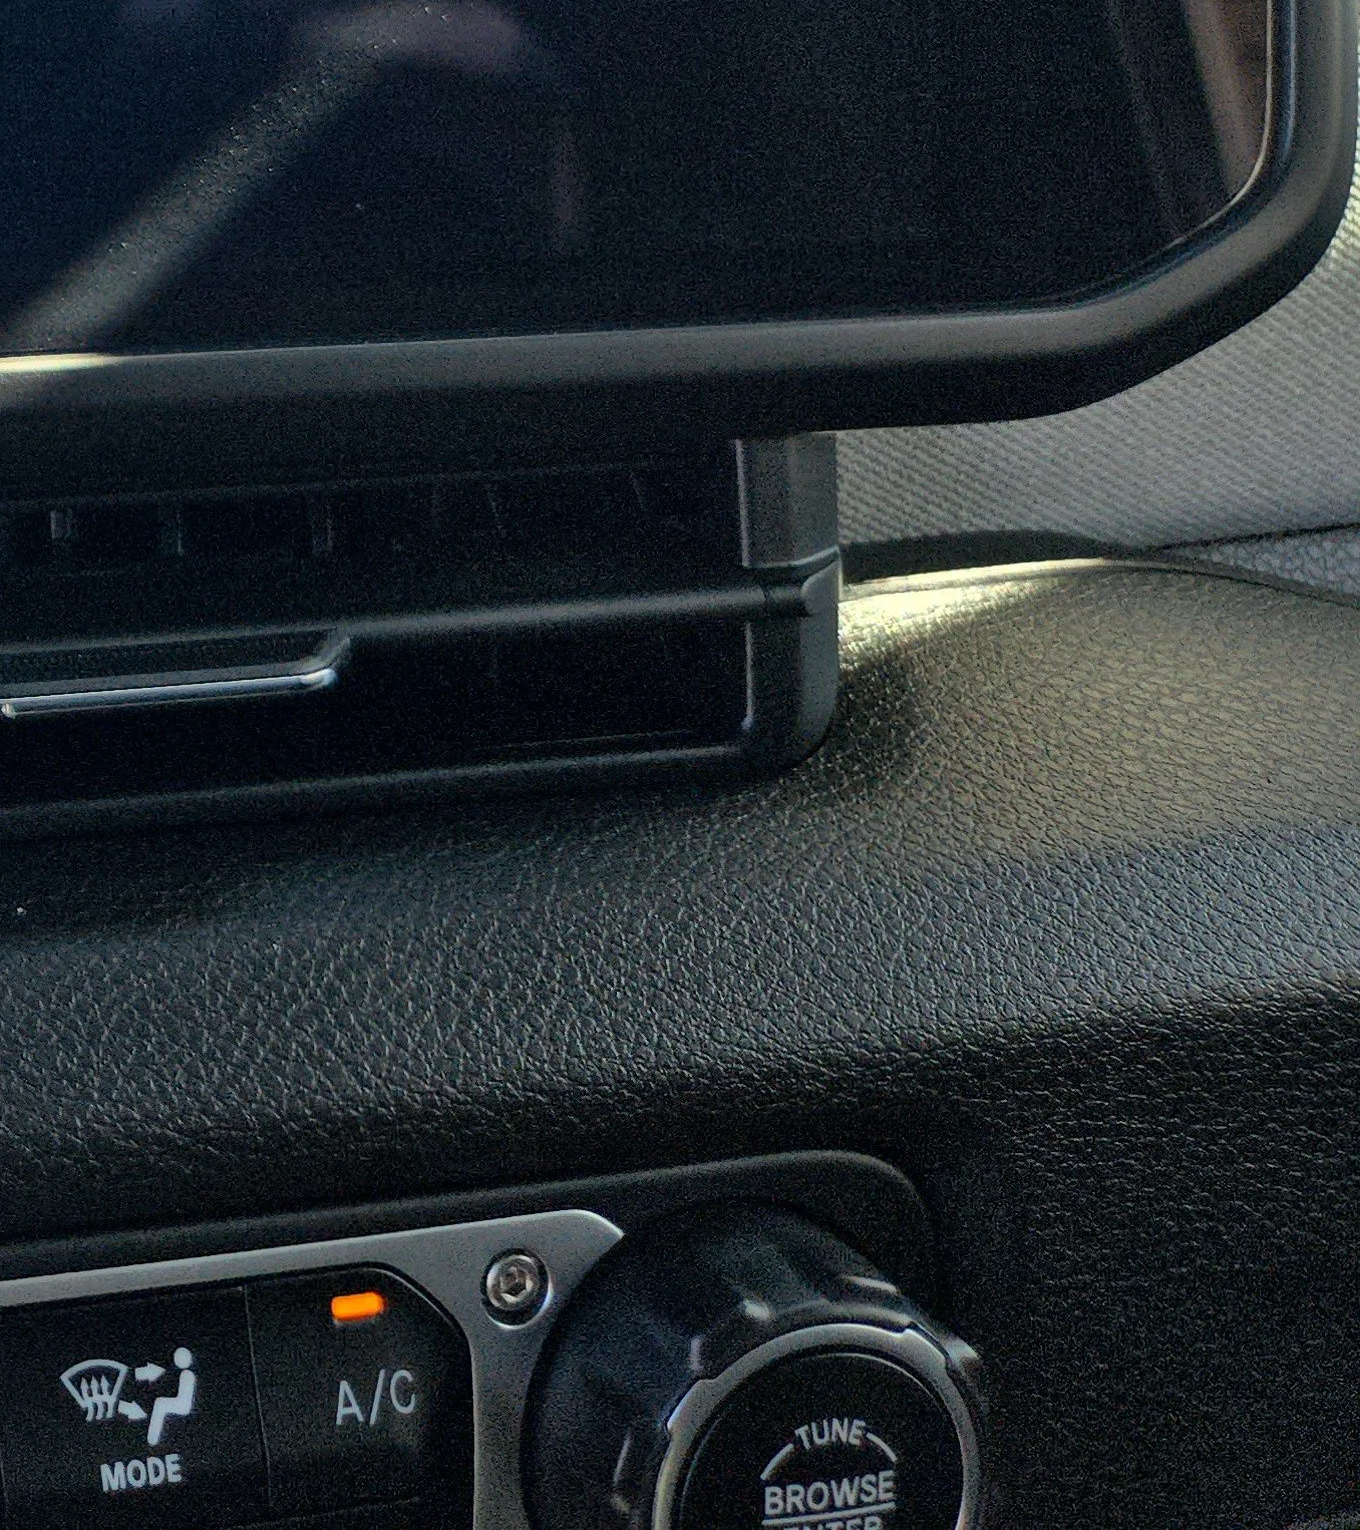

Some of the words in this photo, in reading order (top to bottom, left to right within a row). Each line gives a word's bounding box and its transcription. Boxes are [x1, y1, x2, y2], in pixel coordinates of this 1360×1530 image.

[335, 1369, 416, 1426] A/C
[794, 1417, 867, 1450] TUNE
[99, 1453, 182, 1492] MODE
[764, 1470, 897, 1516] BROWSE
